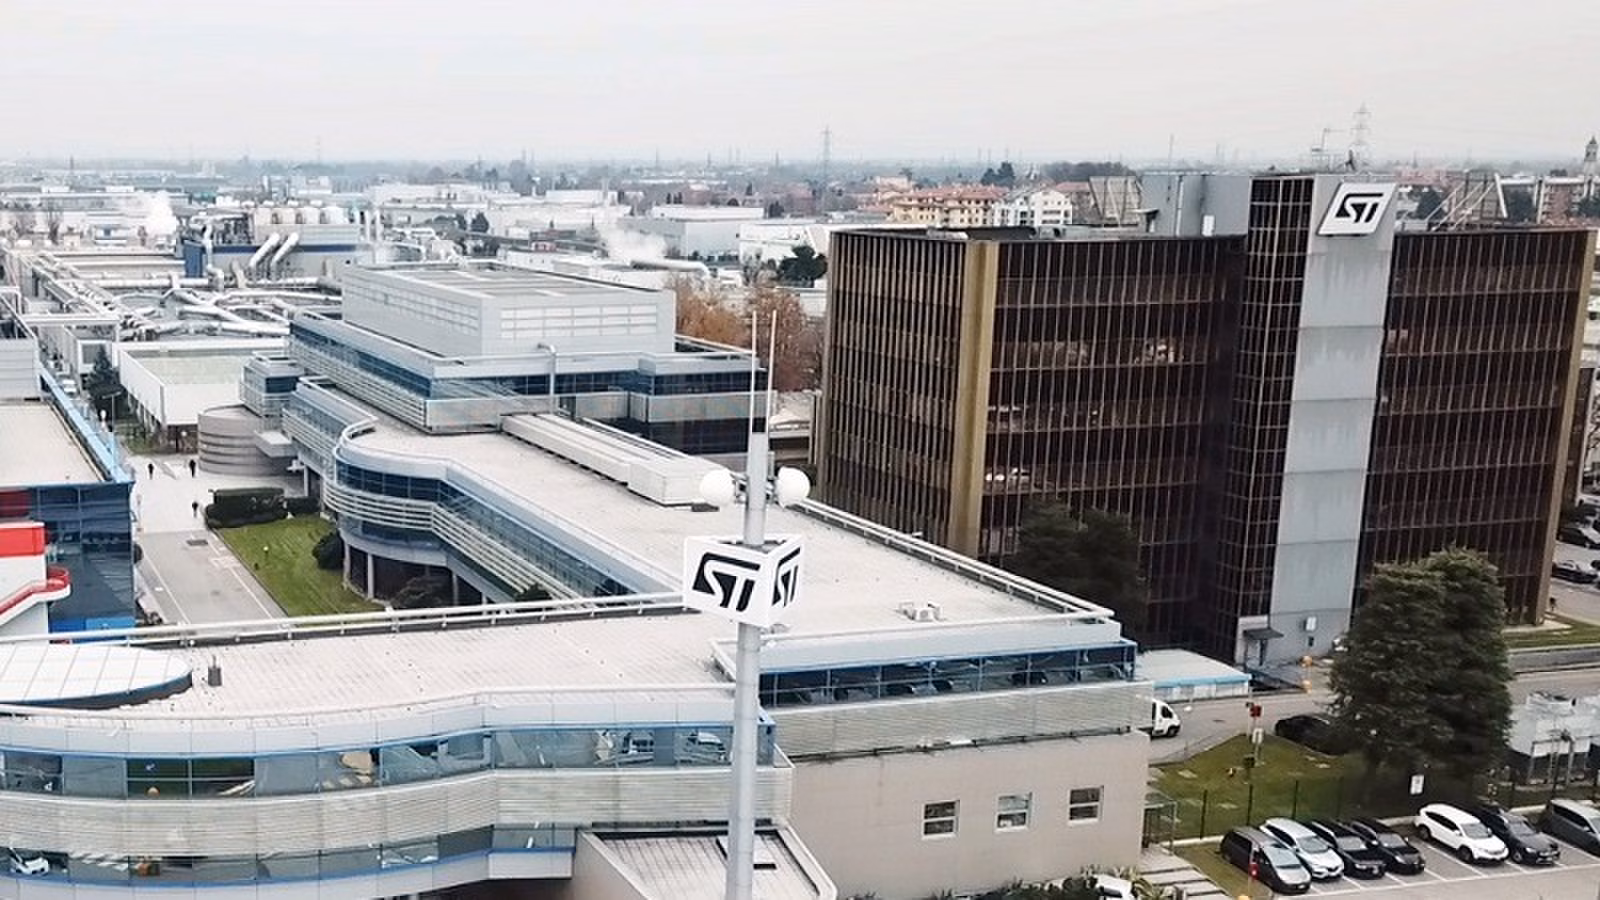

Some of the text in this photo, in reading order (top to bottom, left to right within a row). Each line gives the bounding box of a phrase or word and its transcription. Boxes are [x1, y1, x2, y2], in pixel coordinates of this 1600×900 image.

[1335, 192, 1384, 224] ST
[692, 551, 761, 612] ST
[771, 547, 800, 608] ST
